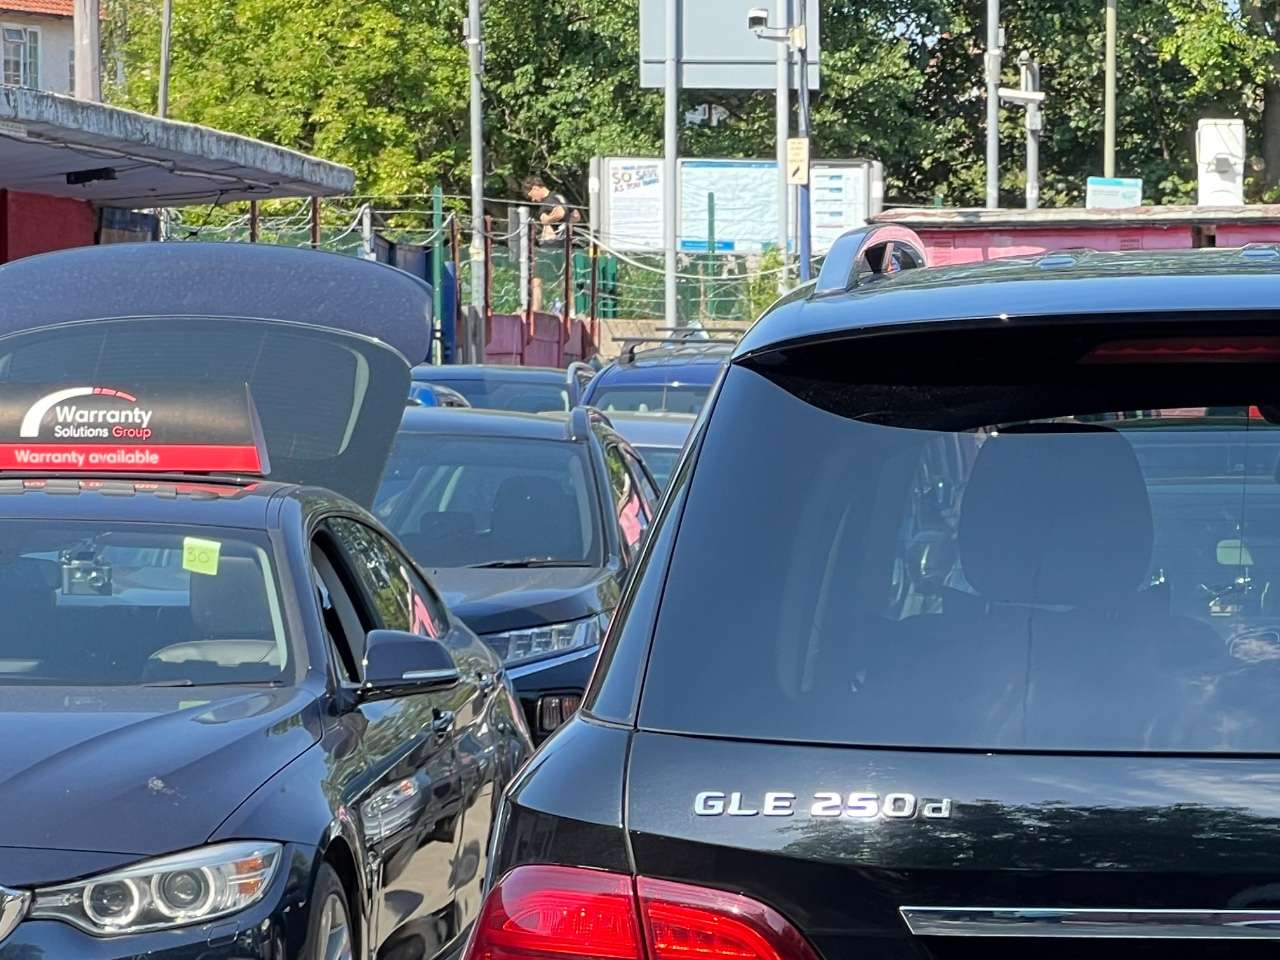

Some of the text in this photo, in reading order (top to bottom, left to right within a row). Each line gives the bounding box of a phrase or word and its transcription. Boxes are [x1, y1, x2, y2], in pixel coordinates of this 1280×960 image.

[55, 405, 152, 428] Warranty
[54, 425, 152, 440] Solutions Group
[15, 449, 159, 466] Warranty available
[694, 791, 952, 819] GLE 250d
